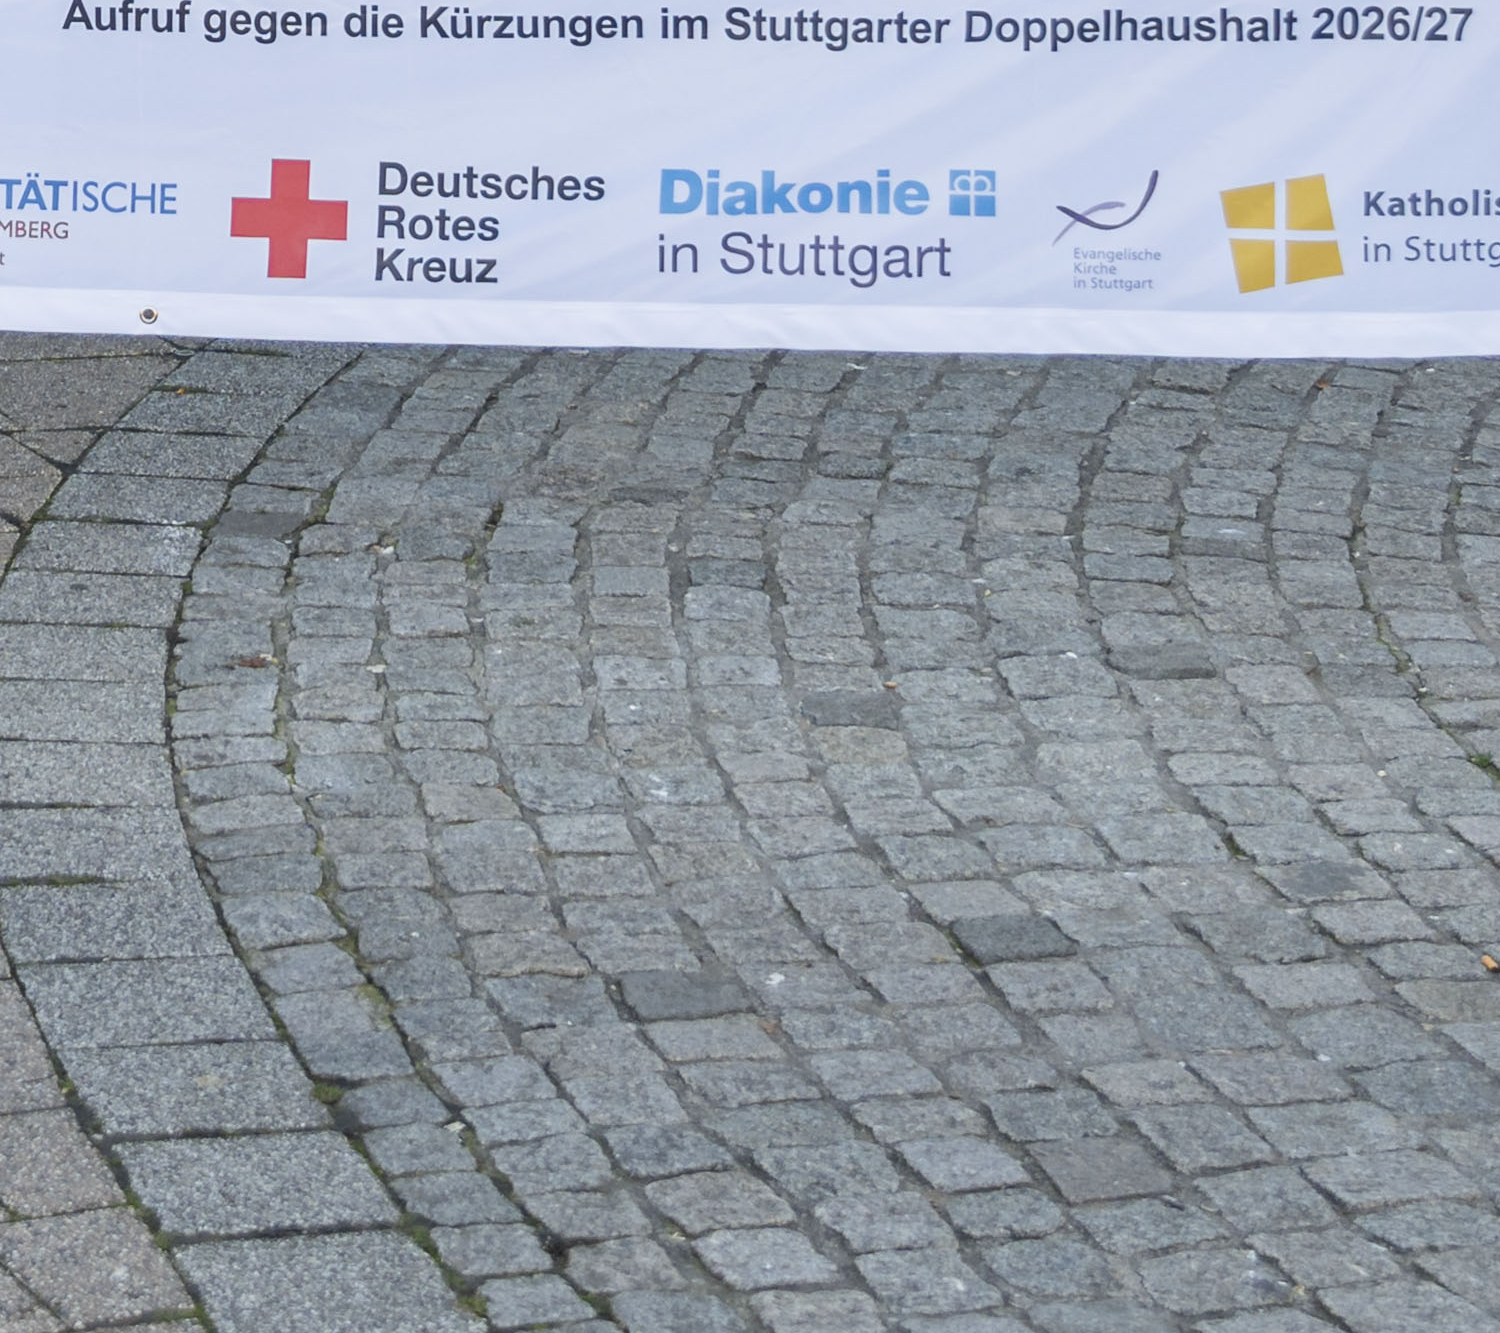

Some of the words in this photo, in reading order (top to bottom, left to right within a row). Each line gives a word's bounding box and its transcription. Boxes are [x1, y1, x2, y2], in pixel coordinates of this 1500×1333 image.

[203, 9, 328, 45] gegen
[343, 4, 404, 39] die
[420, 5, 644, 47] Kürzungen
[661, 7, 708, 40] im
[724, 6, 951, 52] Stuttgarter
[964, 7, 1298, 53] Doppelhaushalt
[1311, 6, 1473, 42] 2026/27
[378, 161, 605, 201] Deutsches
[659, 168, 930, 217] Diakonie
[377, 204, 500, 242] Rotes
[375, 247, 498, 284] Kreuz
[658, 233, 698, 273] in
[720, 231, 952, 289] Stuttgart
[1073, 248, 1162, 263] Evangelische
[1363, 235, 1391, 263] in
[1073, 262, 1117, 275] Kirche
[1073, 276, 1087, 289] in
[1090, 277, 1153, 292] Stuttgart
